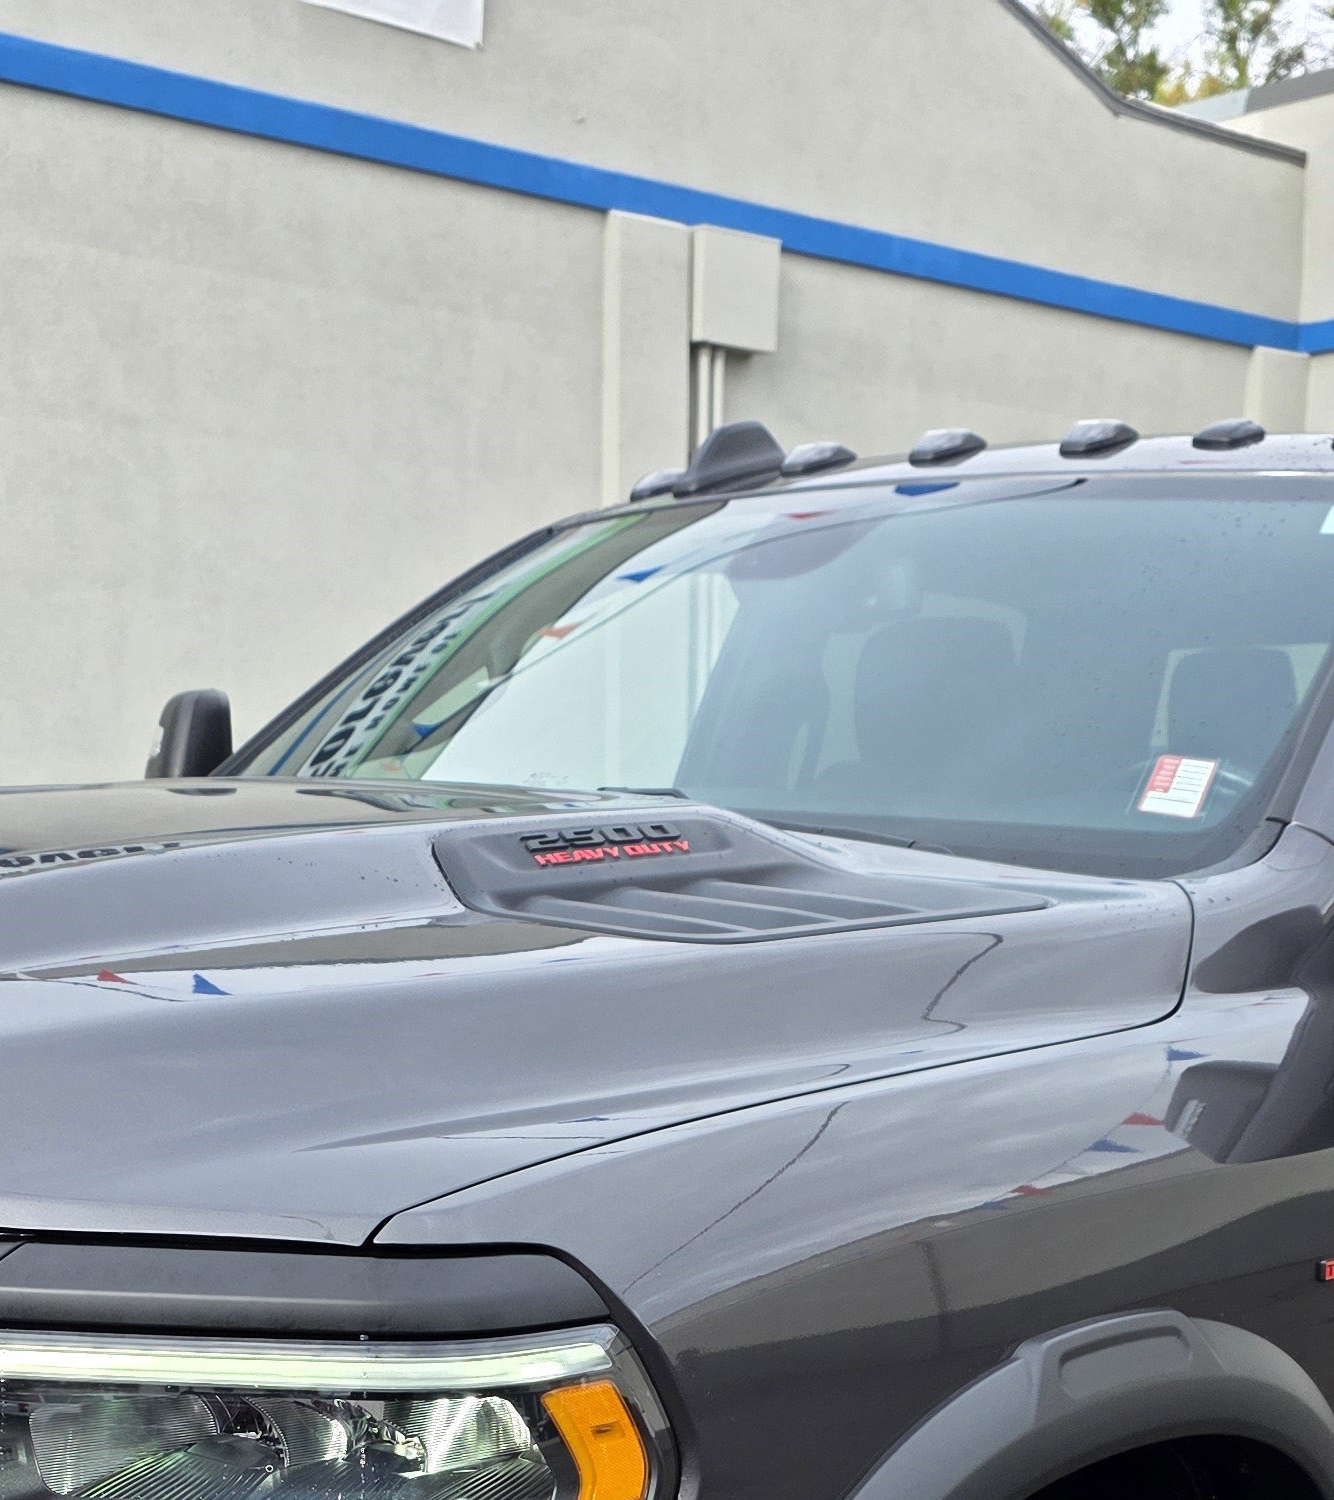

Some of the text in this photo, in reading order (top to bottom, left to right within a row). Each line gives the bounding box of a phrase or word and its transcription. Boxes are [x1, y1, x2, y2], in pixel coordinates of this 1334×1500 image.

[519, 822, 681, 852] 2500
[535, 840, 690, 867] HEAVY DUTY
